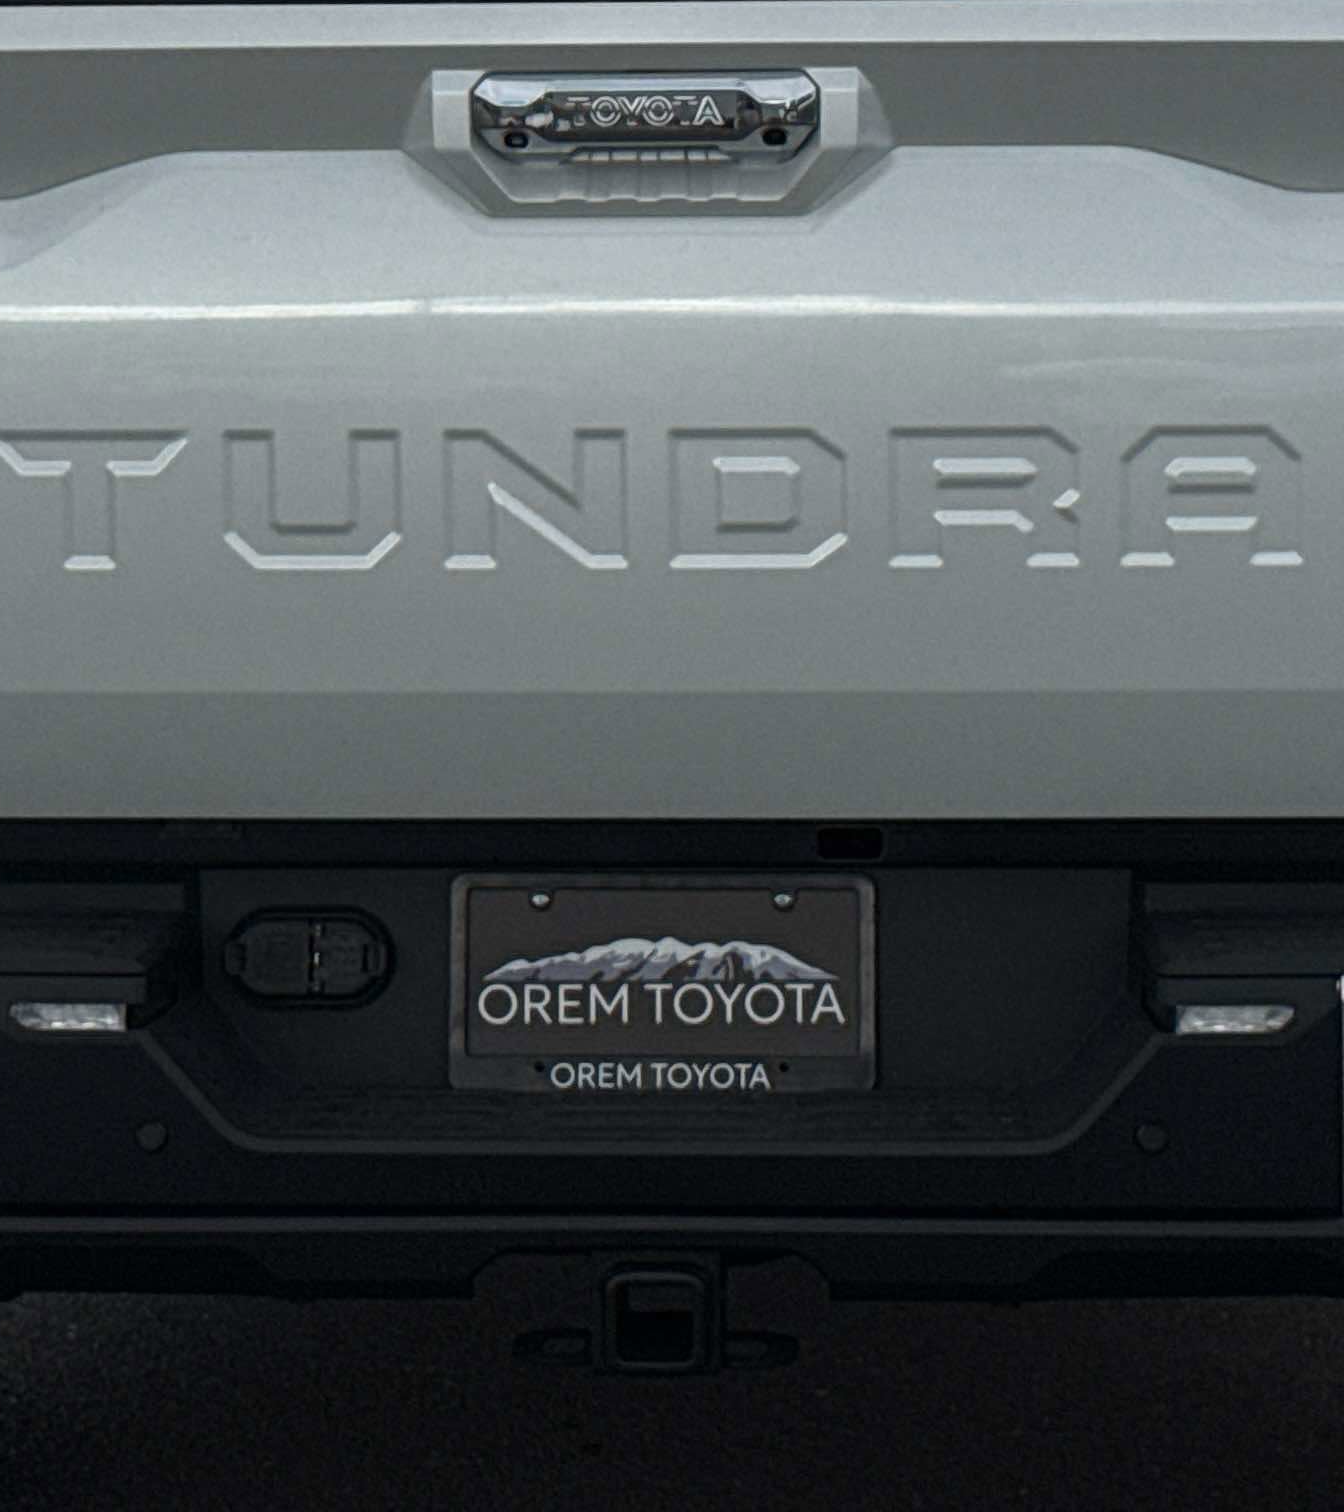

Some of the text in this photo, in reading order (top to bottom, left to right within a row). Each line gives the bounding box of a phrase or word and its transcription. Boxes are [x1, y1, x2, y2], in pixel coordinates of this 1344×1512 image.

[566, 95, 724, 126] TOYOTA
[478, 983, 846, 1025] OREM TOYOTA
[550, 1062, 771, 1089] OREM TOYOTA
